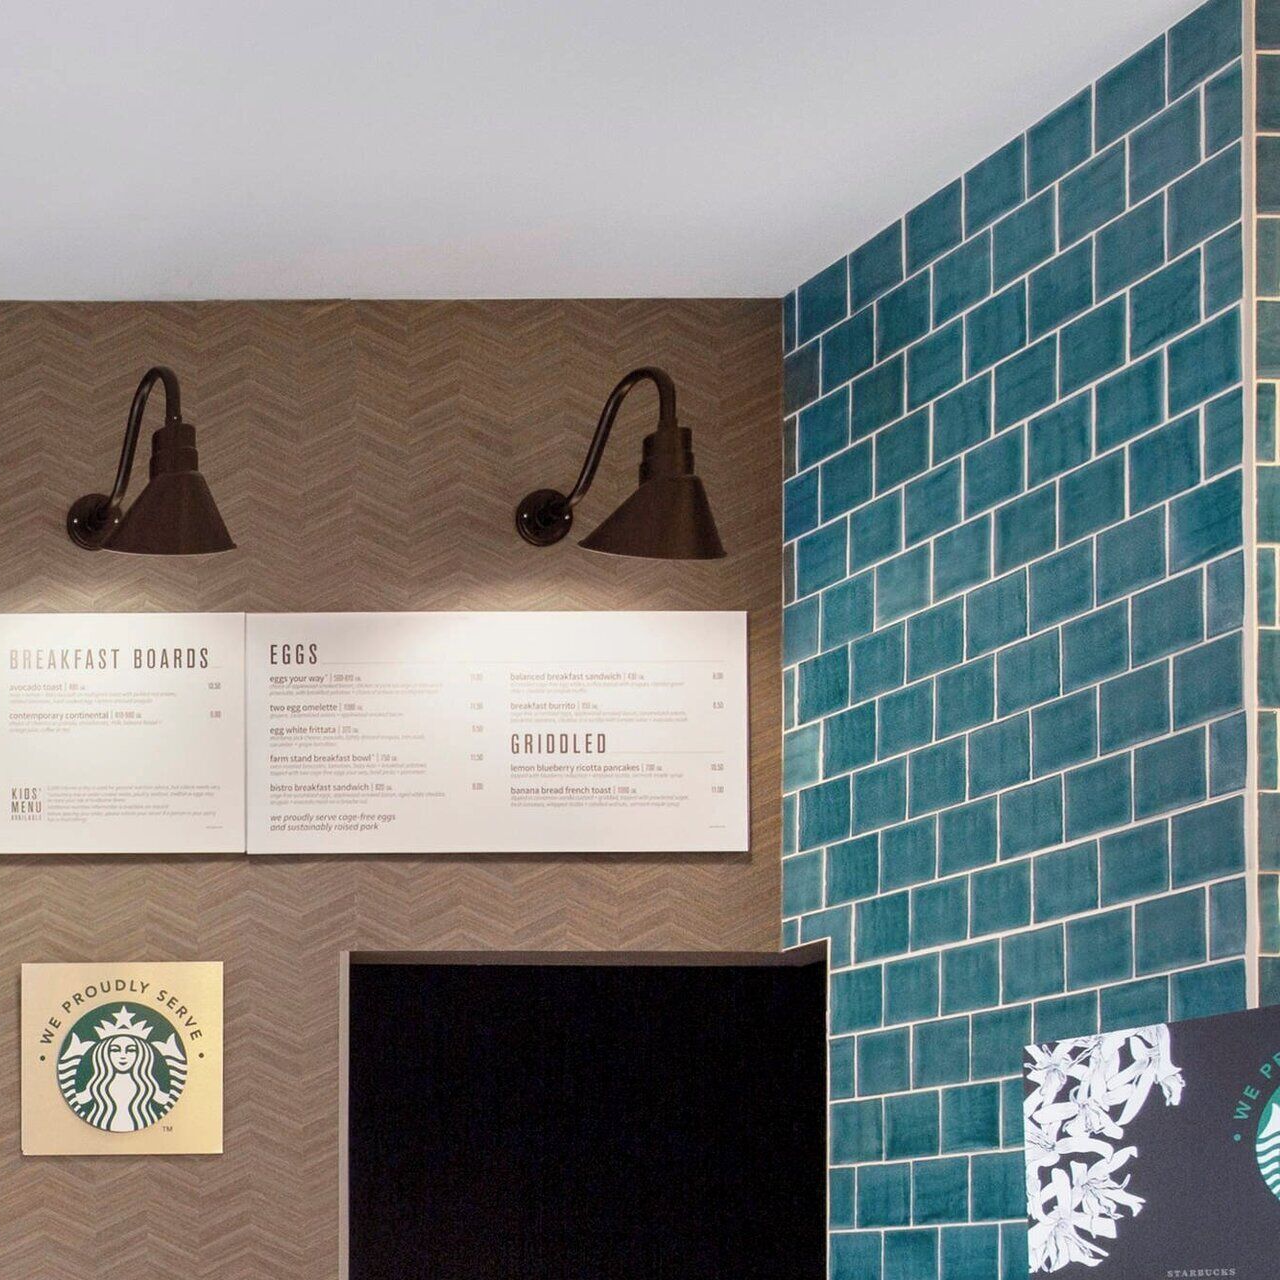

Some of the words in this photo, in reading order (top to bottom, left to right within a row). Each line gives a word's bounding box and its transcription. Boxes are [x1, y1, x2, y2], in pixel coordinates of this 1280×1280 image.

[10, 648, 120, 669] BREAKFAST
[134, 648, 209, 669] BOARDS
[270, 644, 318, 665] EGGS
[269, 676, 288, 684] eggs
[289, 676, 307, 684] your
[511, 673, 545, 681] balanced
[546, 673, 584, 681] breakfast
[585, 673, 622, 681] sandwich
[286, 705, 301, 713] egg
[511, 702, 547, 710] breakfast
[548, 702, 576, 710] burrito
[9, 712, 63, 720] contemporary
[269, 727, 284, 736] egg
[285, 726, 308, 734] white
[309, 726, 336, 734] frittata
[511, 733, 606, 754] GRIDDLED
[269, 754, 289, 762] farm
[290, 754, 312, 762] stand
[313, 754, 350, 762] breakfast
[511, 764, 535, 772] lemon
[536, 764, 574, 773] blueberry
[576, 764, 602, 772] ricotta
[603, 764, 640, 773] pancakes
[270, 784, 293, 792] bistro
[294, 784, 331, 792] breakfast
[332, 784, 369, 792] sandwich
[11, 801, 42, 813] MENU
[283, 814, 314, 823] proudly
[376, 814, 396, 823] eggs
[270, 823, 286, 831] and
[287, 823, 333, 833] sustainably
[334, 823, 359, 831] raised
[360, 822, 379, 832] pork
[40, 1016, 62, 1046] WE
[61, 979, 150, 1014] PROUDLY
[156, 989, 203, 1041] SERVE
[1233, 1085, 1260, 1119] WE
[1167, 1268, 1236, 1278] STARBUCKS
